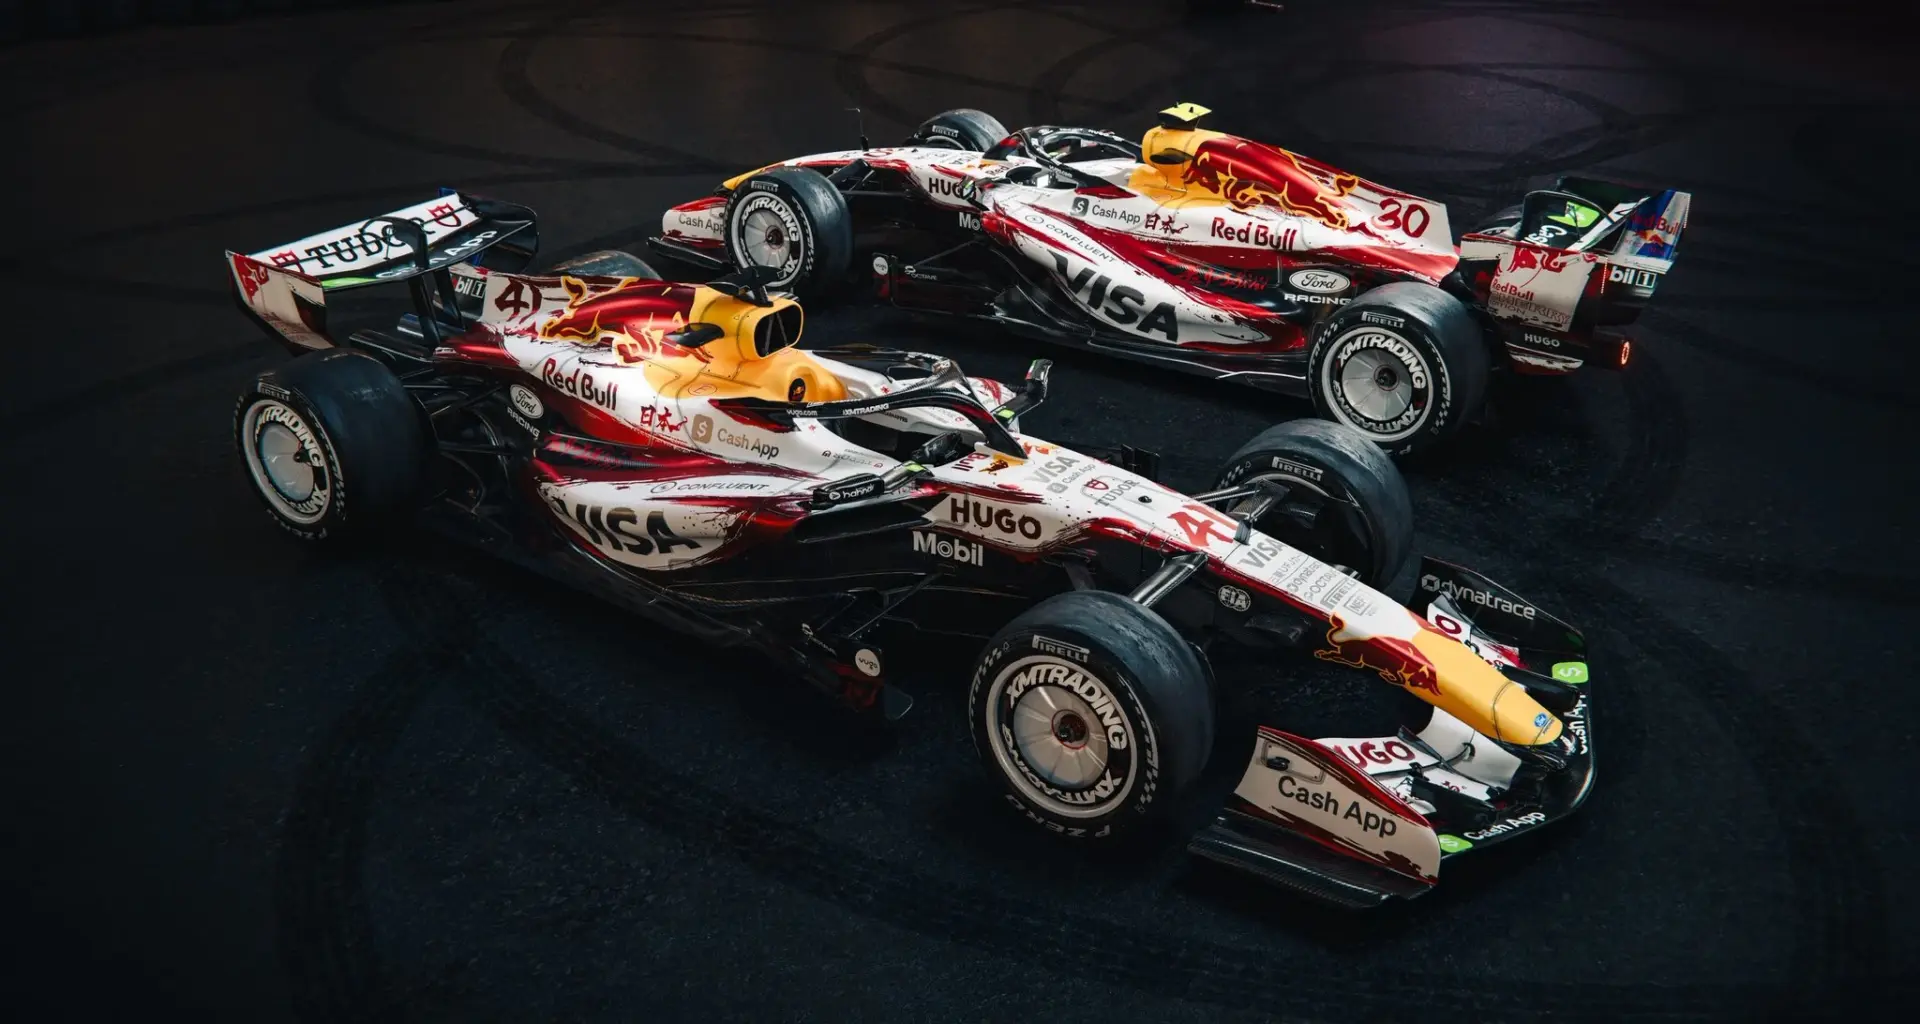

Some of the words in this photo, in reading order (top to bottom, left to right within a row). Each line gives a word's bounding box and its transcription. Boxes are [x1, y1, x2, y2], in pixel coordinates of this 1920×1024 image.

[678, 213, 704, 229] Cash
[1092, 204, 1118, 219] Cash
[1118, 207, 1141, 225] App
[1371, 198, 1430, 238] 30
[1045, 223, 1117, 264] CONFLUENT
[1211, 216, 1252, 244] Red
[1254, 224, 1298, 251] Bull
[1300, 272, 1337, 290] Ford
[1604, 264, 1635, 284] bil
[494, 278, 543, 325] 41
[1047, 249, 1180, 343] VISA
[1284, 293, 1353, 305] RACING
[1492, 279, 1510, 293] Red
[1509, 285, 1534, 301] Bull
[1361, 311, 1405, 329] PIRELLI
[1524, 333, 1561, 347] HUGO
[1338, 333, 1427, 389] XMTRADING
[542, 358, 580, 398] Red
[580, 372, 619, 411] Bull
[514, 389, 538, 414] Ford
[844, 403, 890, 416] XMTRADING
[506, 407, 541, 441] RACING
[717, 428, 749, 450] Cash
[750, 437, 780, 460] App
[951, 452, 990, 472] Bull
[1030, 455, 1081, 484] VISA
[1271, 456, 1324, 482] PIRELLI
[677, 481, 771, 492] CONFLUENT
[1062, 471, 1080, 484] Cash
[1094, 478, 1140, 508] TUDOR
[551, 497, 702, 556] VISA
[950, 496, 1042, 540] HUGO
[912, 529, 984, 567] Mobil
[1237, 538, 1288, 568] VISA
[1441, 579, 1536, 620] dynatrace
[1032, 634, 1091, 664] PIRELLI
[1006, 664, 1128, 750] XMTRADING
[1333, 740, 1416, 769] UGO
[1277, 775, 1340, 816] Cash
[1343, 805, 1398, 838] App
[1463, 822, 1508, 841] Cash
[1511, 811, 1547, 828] App
